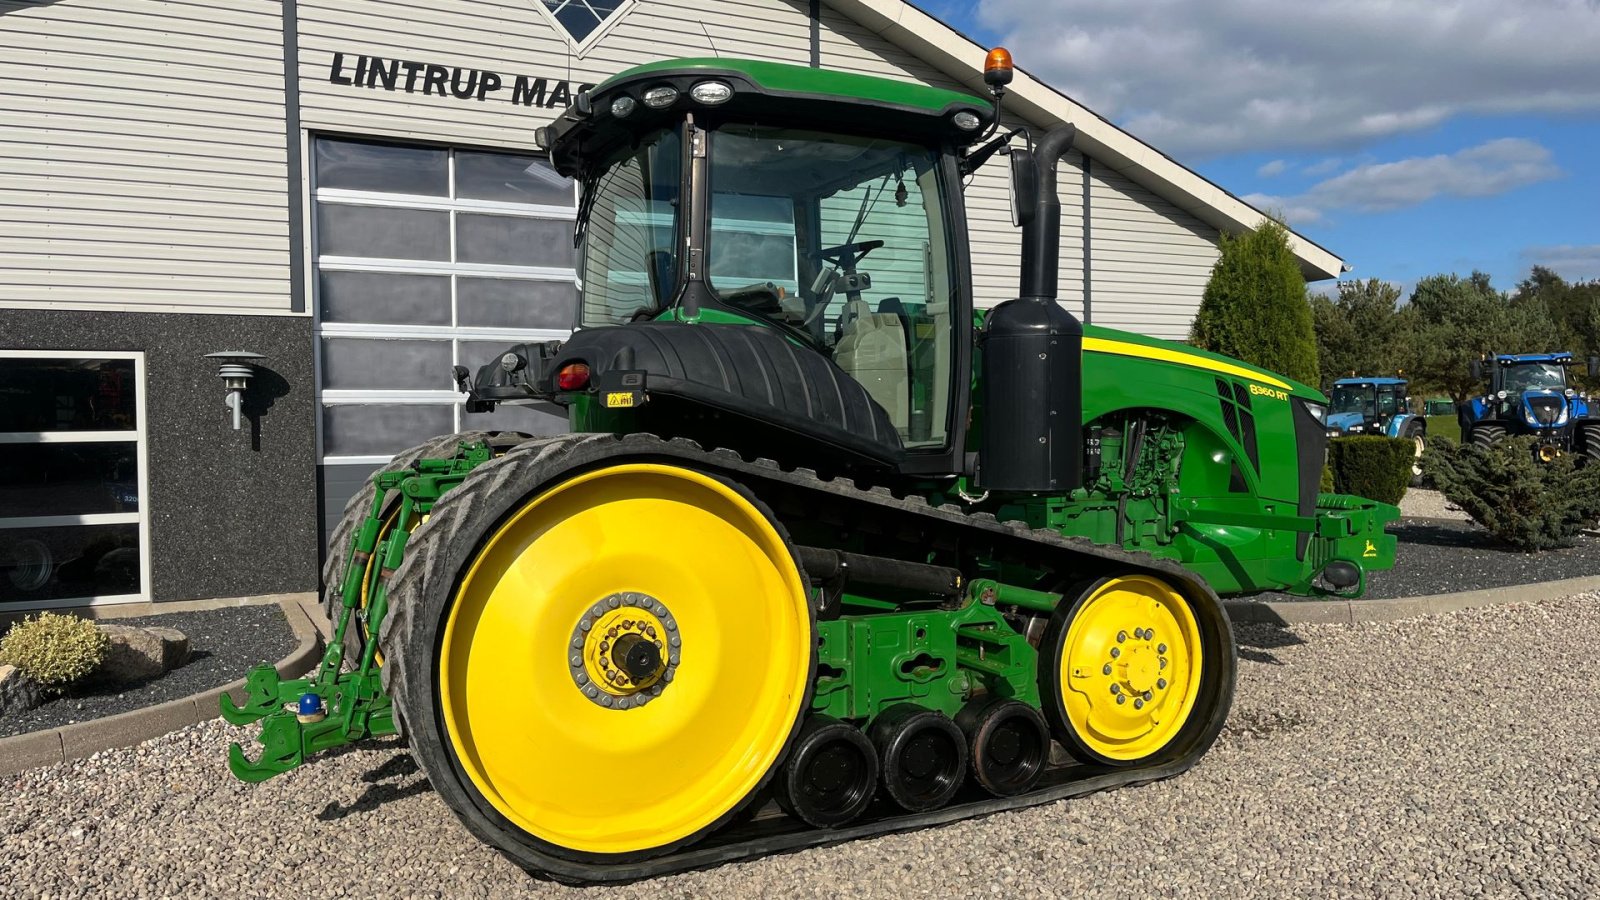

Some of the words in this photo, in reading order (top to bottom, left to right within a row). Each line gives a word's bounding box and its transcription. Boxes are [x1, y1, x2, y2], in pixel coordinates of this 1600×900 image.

[330, 52, 501, 101] LINTRUP
[1249, 384, 1275, 398] 8360
[1275, 390, 1288, 401] RT
